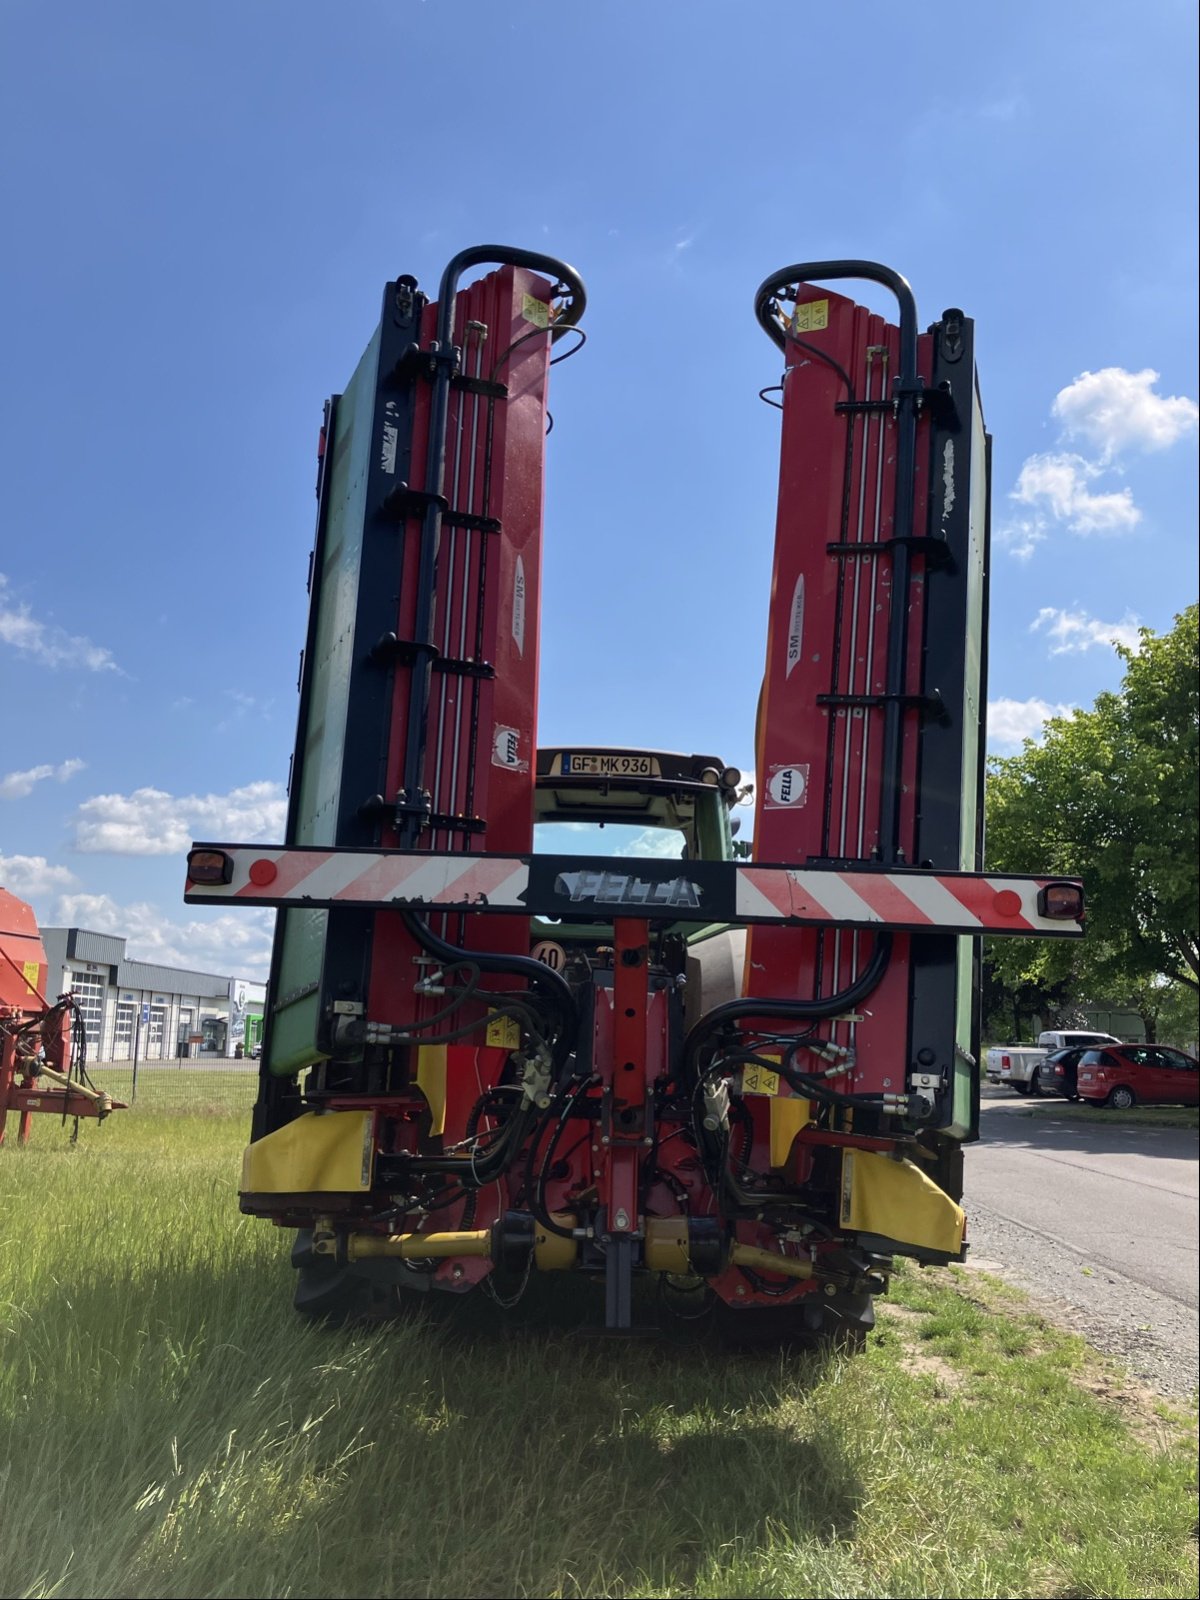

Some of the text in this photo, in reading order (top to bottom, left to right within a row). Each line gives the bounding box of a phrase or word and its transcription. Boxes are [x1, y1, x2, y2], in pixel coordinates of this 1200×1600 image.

[516, 575, 524, 599] SM
[788, 635, 799, 659] SM
[507, 732, 516, 763] FELLA
[572, 757, 649, 773] GF MK 936
[780, 769, 793, 802] FELLA
[569, 870, 700, 908] FELLA
